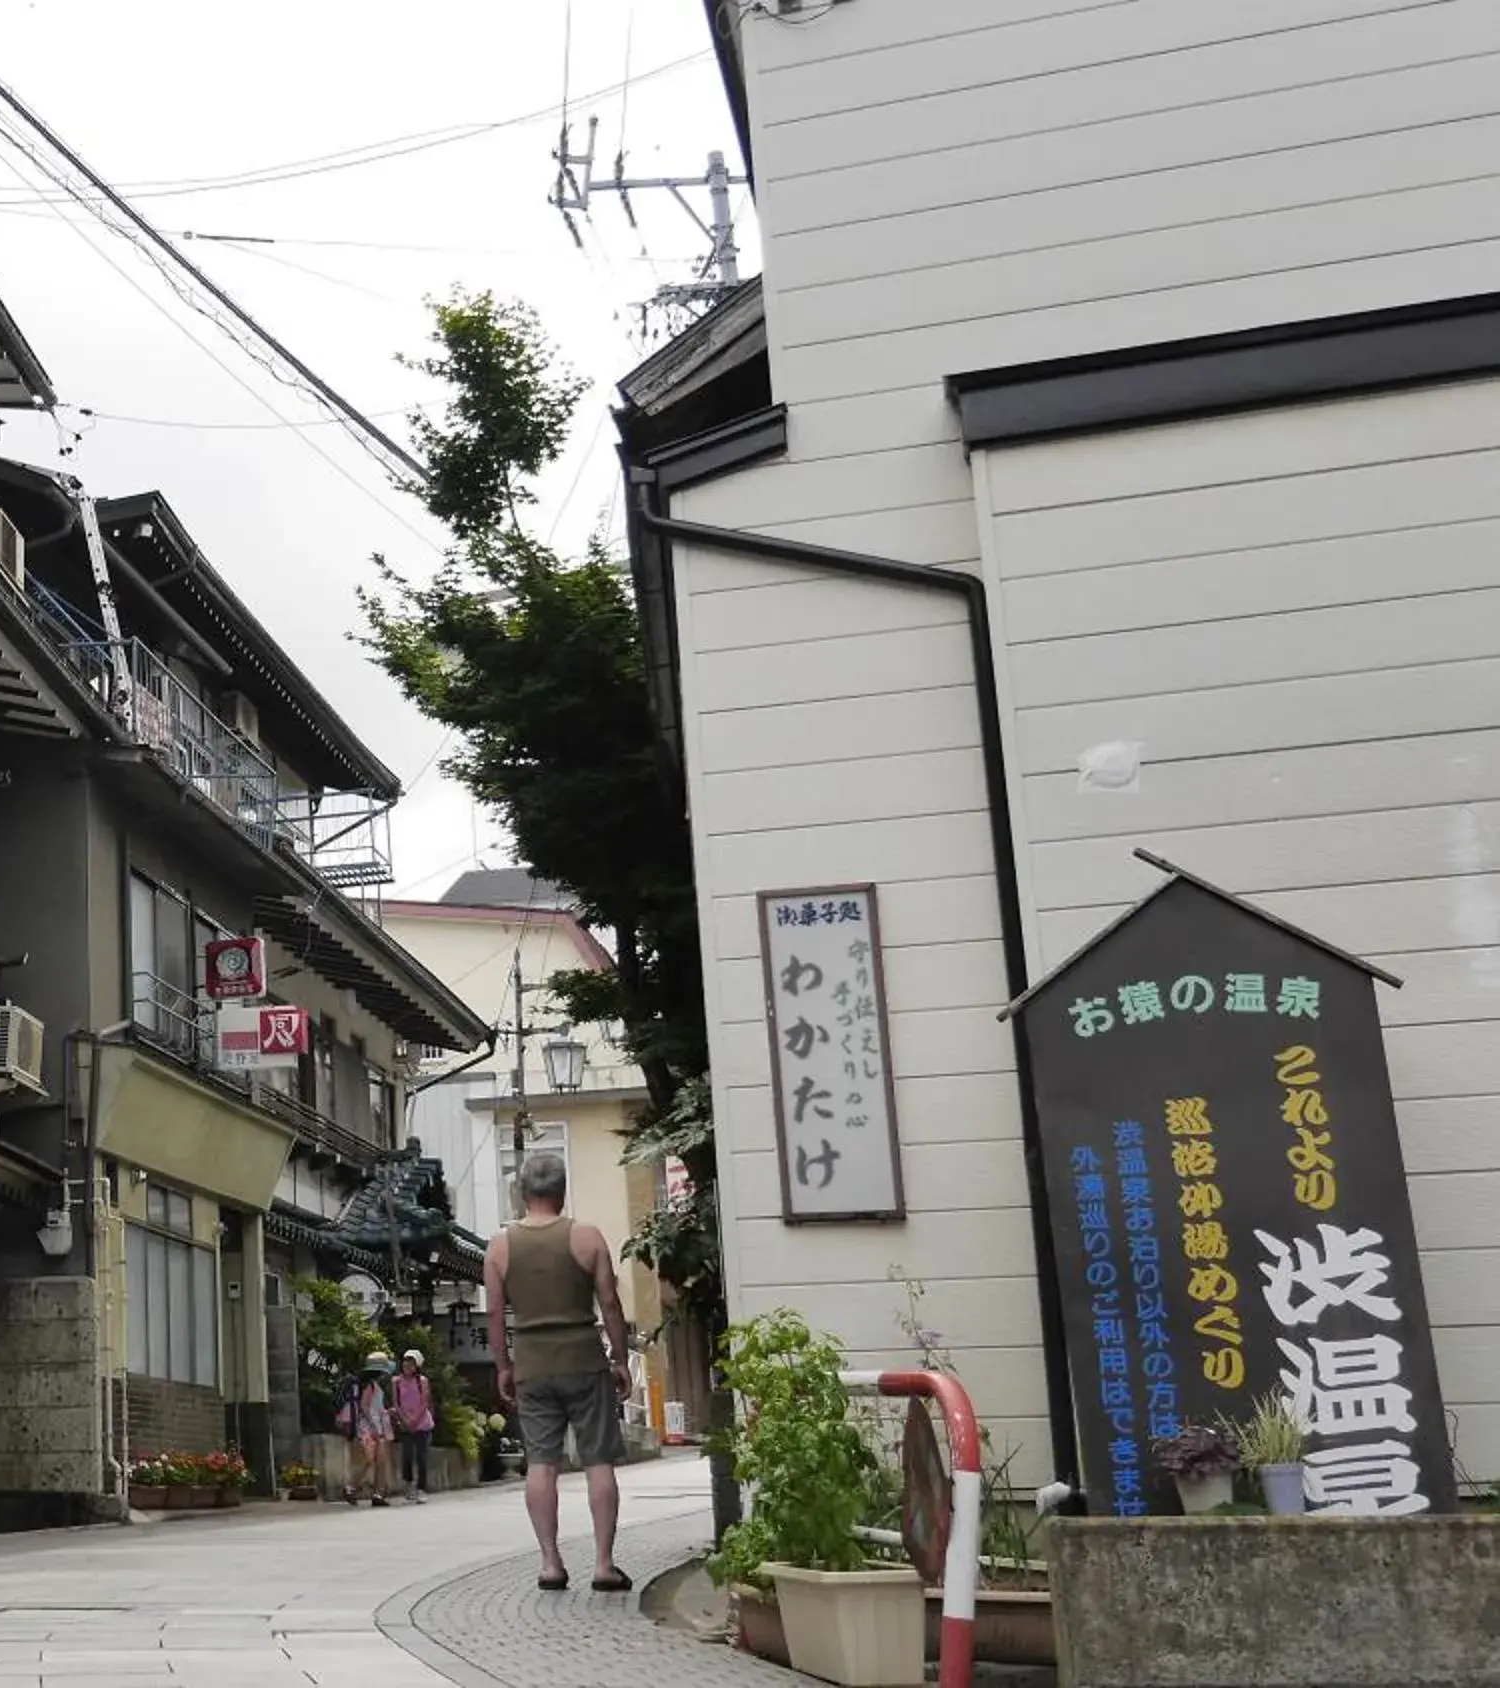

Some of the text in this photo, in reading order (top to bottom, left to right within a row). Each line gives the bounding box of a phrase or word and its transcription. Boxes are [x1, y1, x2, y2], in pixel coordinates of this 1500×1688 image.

[781, 954, 841, 1191] わかたけ
[1068, 973, 1321, 1038] お猿の温泉
[1272, 1044, 1337, 1212] これより
[1112, 1119, 1186, 1441] 渋温泉お泊り以外の方は
